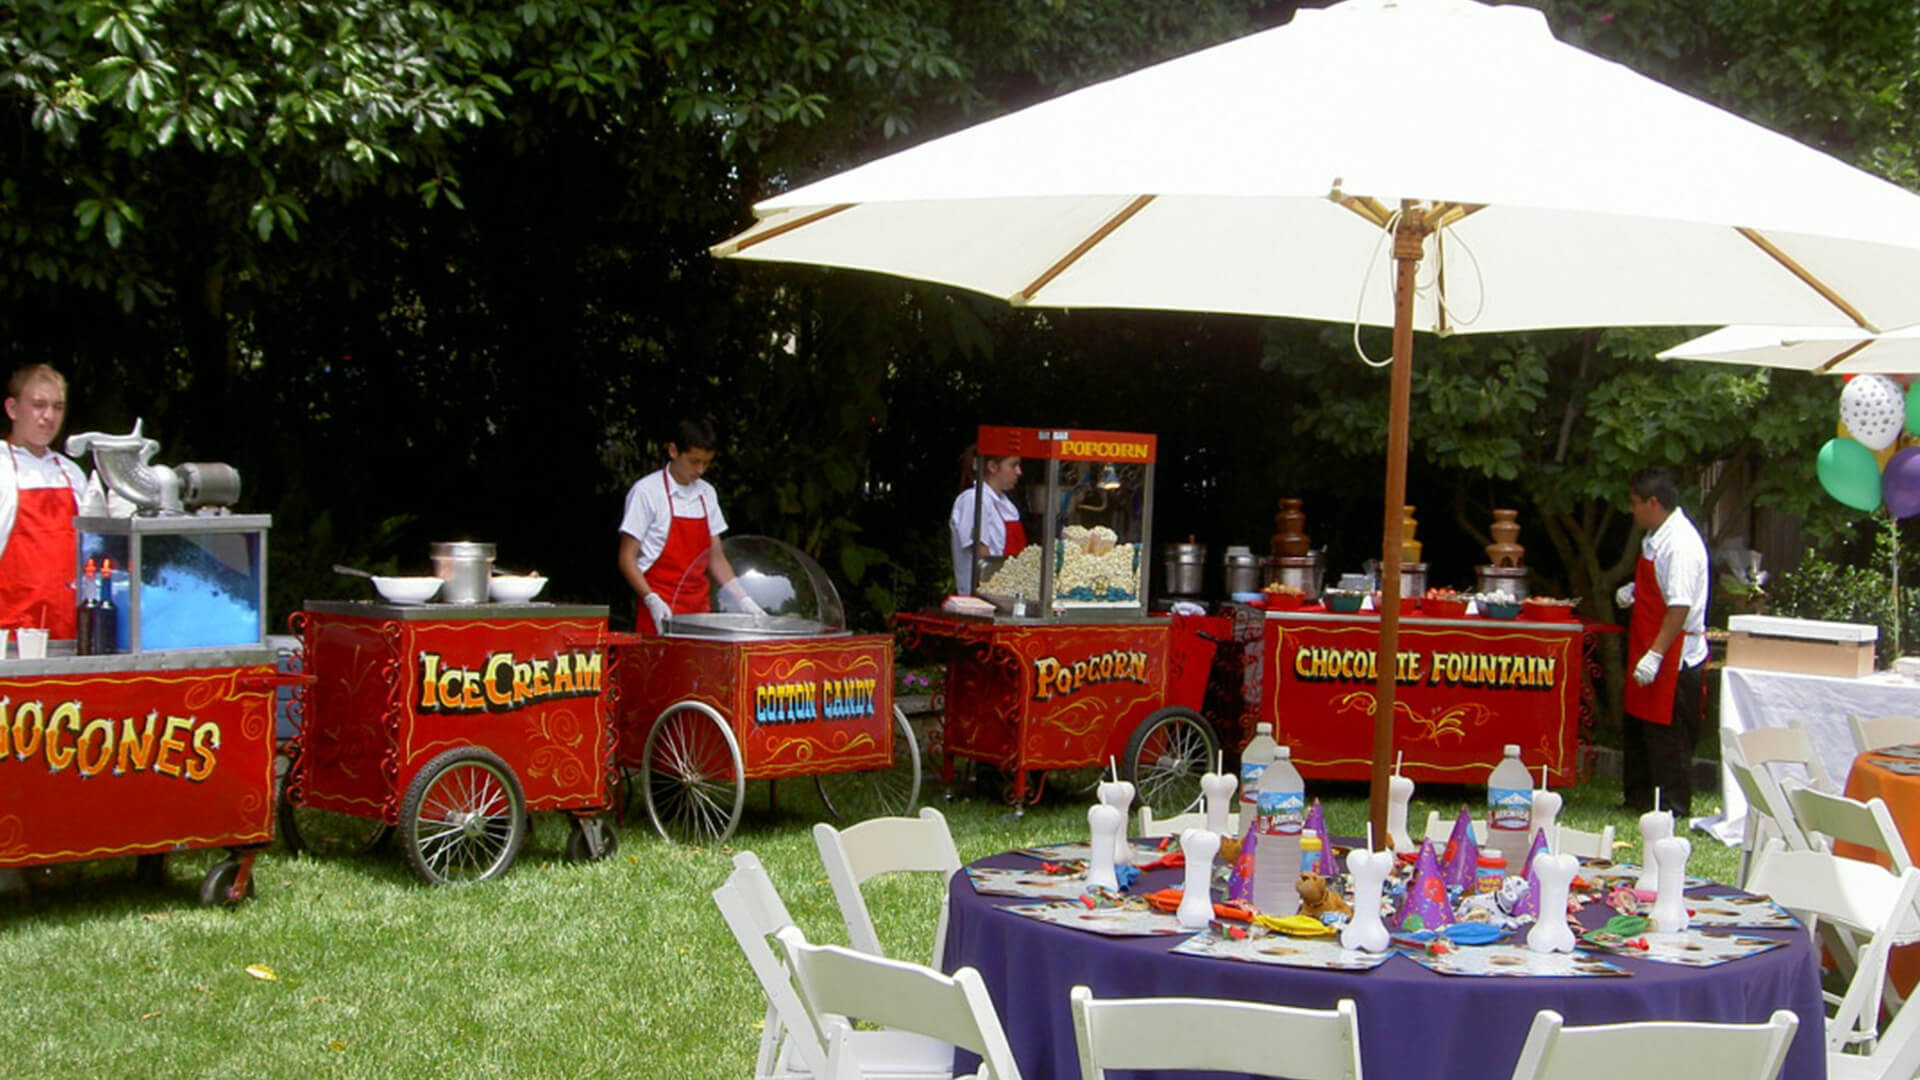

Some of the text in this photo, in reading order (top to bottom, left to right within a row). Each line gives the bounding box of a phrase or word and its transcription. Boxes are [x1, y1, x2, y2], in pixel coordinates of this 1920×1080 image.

[1060, 440, 1149, 458] POPCORN
[1034, 650, 1147, 698] POPCORN
[1295, 647, 1556, 686] CHOCOLTE FOUNTAIN
[756, 678, 876, 722] COTTON CANDY
